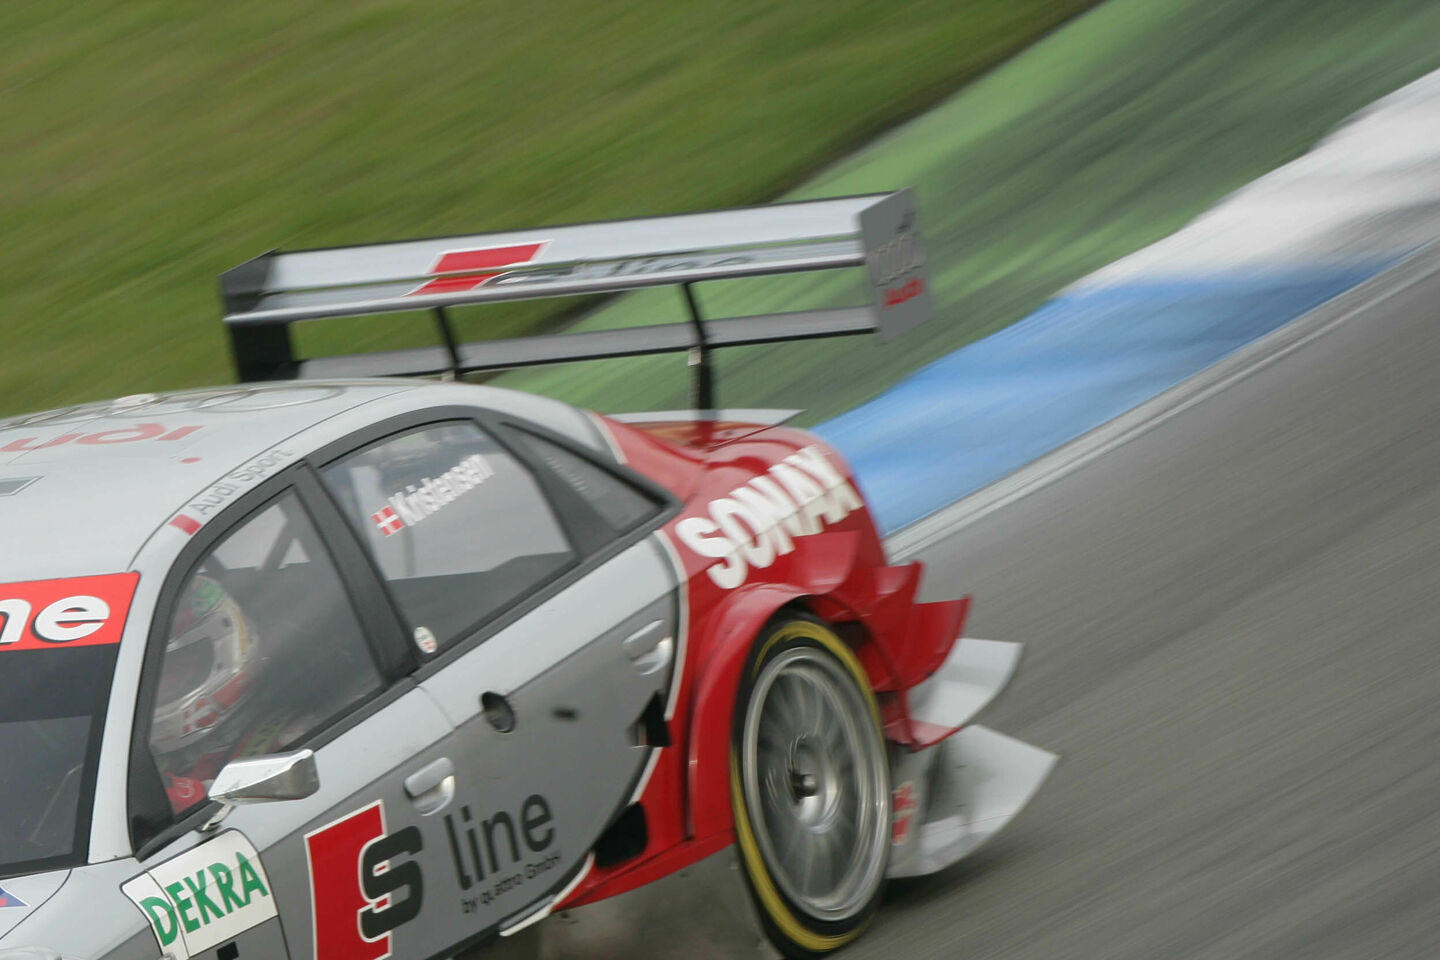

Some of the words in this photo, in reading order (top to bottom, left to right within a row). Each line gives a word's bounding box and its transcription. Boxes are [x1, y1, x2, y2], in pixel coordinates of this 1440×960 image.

[188, 481, 240, 515] Audi
[228, 450, 295, 481] Sport
[675, 444, 865, 589] SONAX
[444, 794, 555, 891] line
[139, 851, 269, 947] DEKRA
